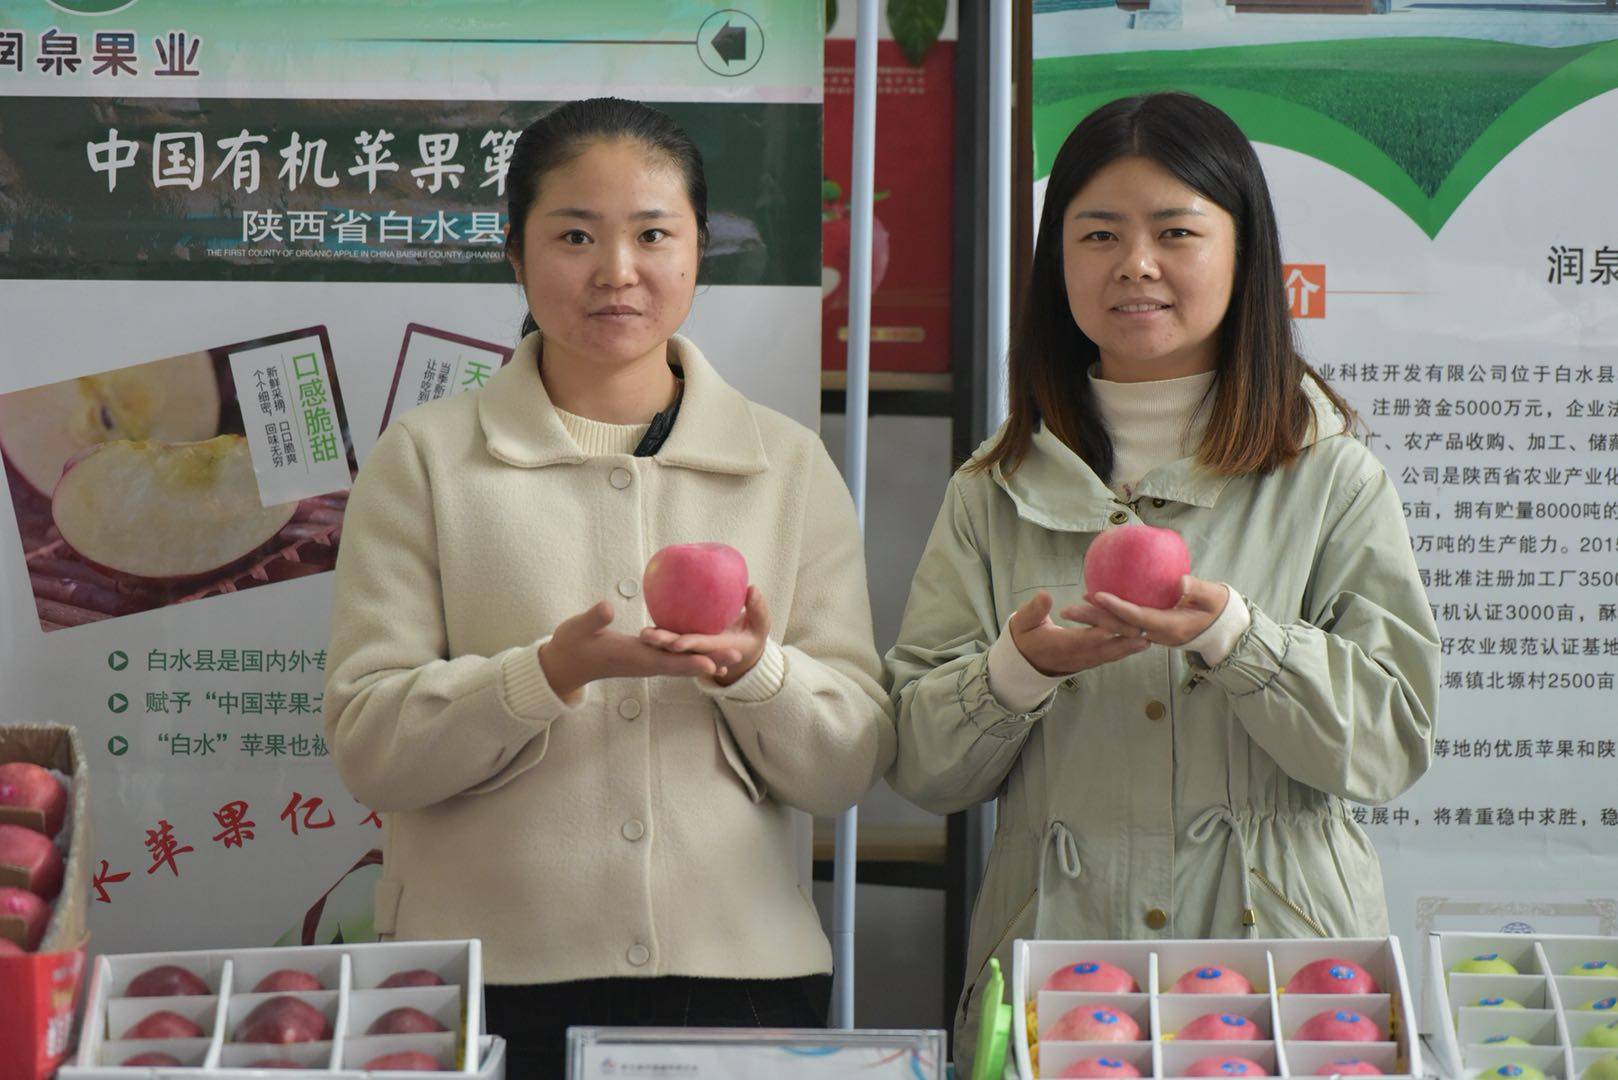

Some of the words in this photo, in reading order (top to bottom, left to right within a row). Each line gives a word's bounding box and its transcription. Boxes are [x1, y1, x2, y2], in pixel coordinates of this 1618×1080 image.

[87, 128, 523, 196] 中国有机苹果第
[242, 210, 504, 244] 陕西省白水县
[207, 248, 221, 257] THE
[224, 249, 246, 257] FIRST
[248, 249, 280, 257] COUNTY
[283, 249, 294, 257] OF
[296, 249, 332, 257] ORGANIC
[334, 249, 358, 258] APPLE
[361, 249, 369, 258] IN
[371, 249, 395, 258] CHINA
[1547, 245, 1618, 286] 润泉
[416, 358, 436, 406] 让你吃到
[461, 360, 492, 391] 天
[1319, 363, 1614, 384] 业科技开发有限公司位于白水县
[292, 351, 340, 464] 口感脆甜
[1354, 432, 1618, 452] 广、农产品收购、加工、储
[1401, 466, 1618, 487] 公司是陕西省农业产业化
[1409, 534, 1618, 555] 万吨的生产能力。201
[1418, 568, 1618, 588] 局批准注册加工厂350
[1440, 636, 1618, 656] 好农业规范认证基地
[147, 648, 327, 673] 白水县是国内外专
[1440, 670, 1614, 690] 塬镇北塬村2500亩
[1433, 738, 1616, 759] 等地的优质苹果和陕
